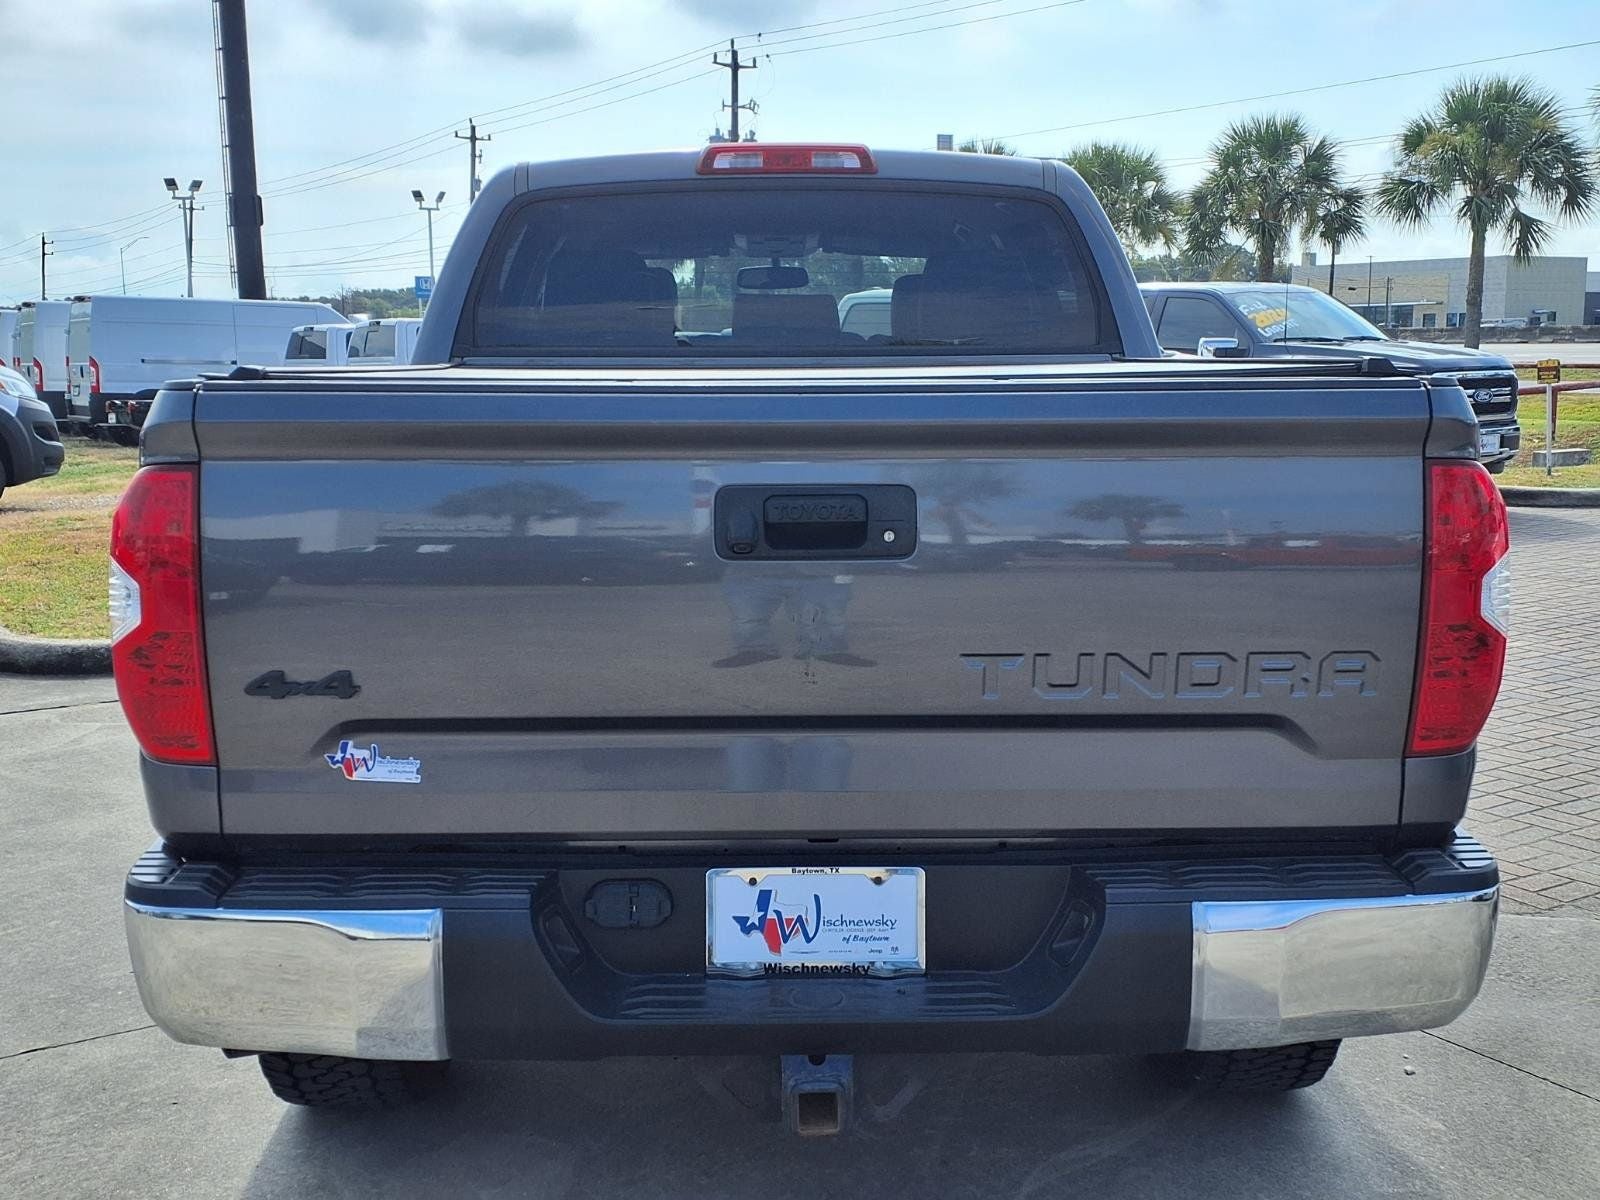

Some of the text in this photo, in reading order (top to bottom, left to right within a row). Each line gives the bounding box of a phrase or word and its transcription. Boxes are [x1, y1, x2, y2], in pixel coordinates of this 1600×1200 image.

[773, 503, 859, 521] TOYOTA
[959, 651, 1382, 699] TUNDRA
[852, 934, 890, 943] Baytown
[763, 962, 871, 975] Wischnewsky
